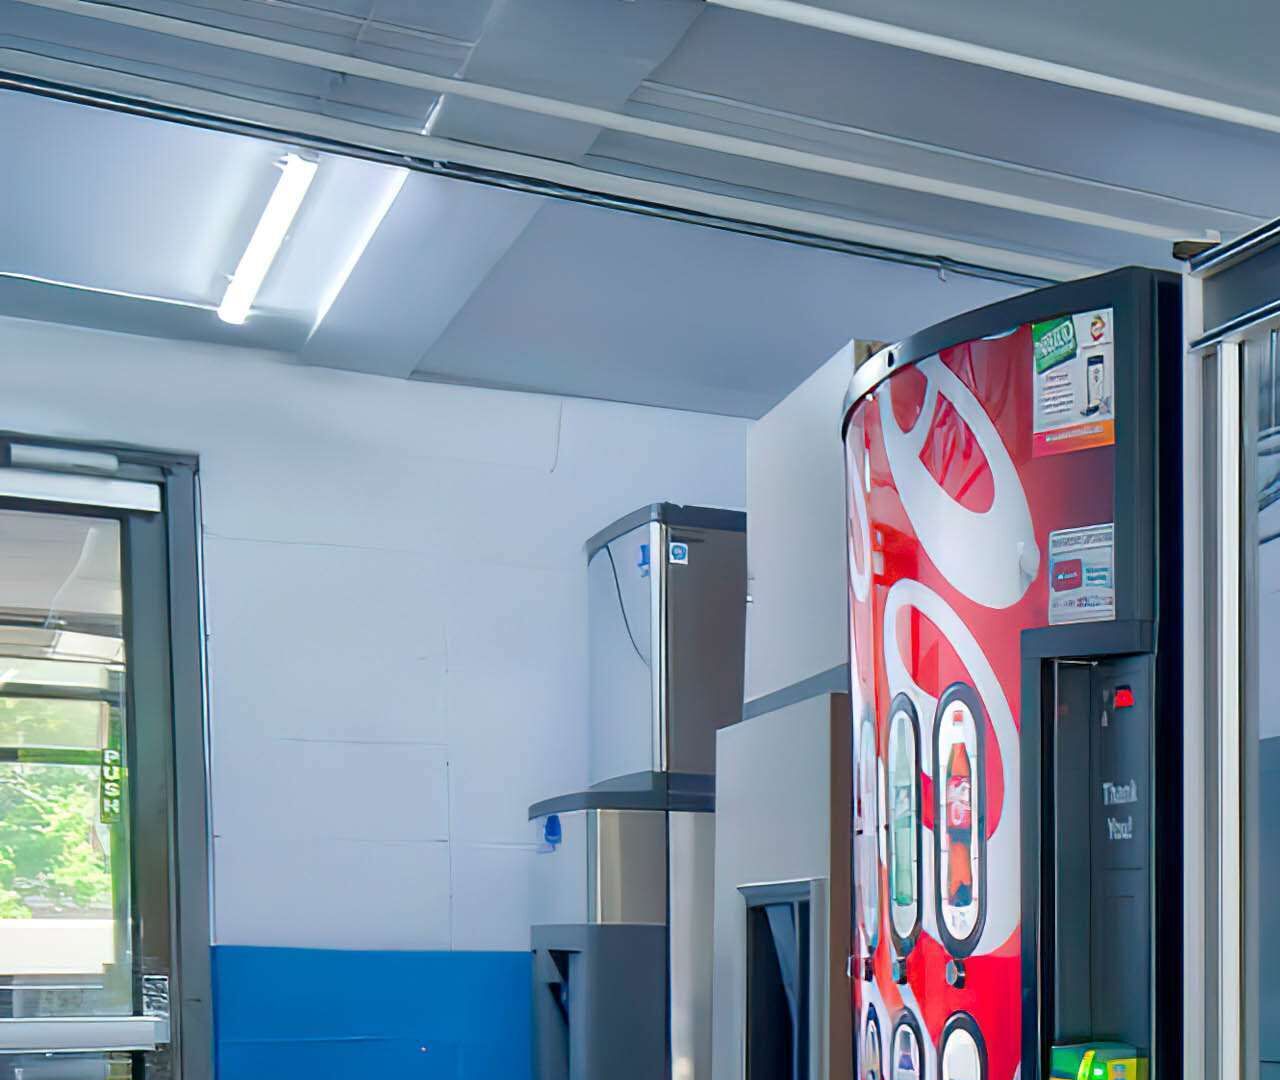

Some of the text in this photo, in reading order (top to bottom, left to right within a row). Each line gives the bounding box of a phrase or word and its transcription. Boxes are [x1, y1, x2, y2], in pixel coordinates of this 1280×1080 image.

[102, 749, 121, 814] PUSH
[1102, 778, 1138, 806] Thank
[1107, 815, 1133, 841] You!
